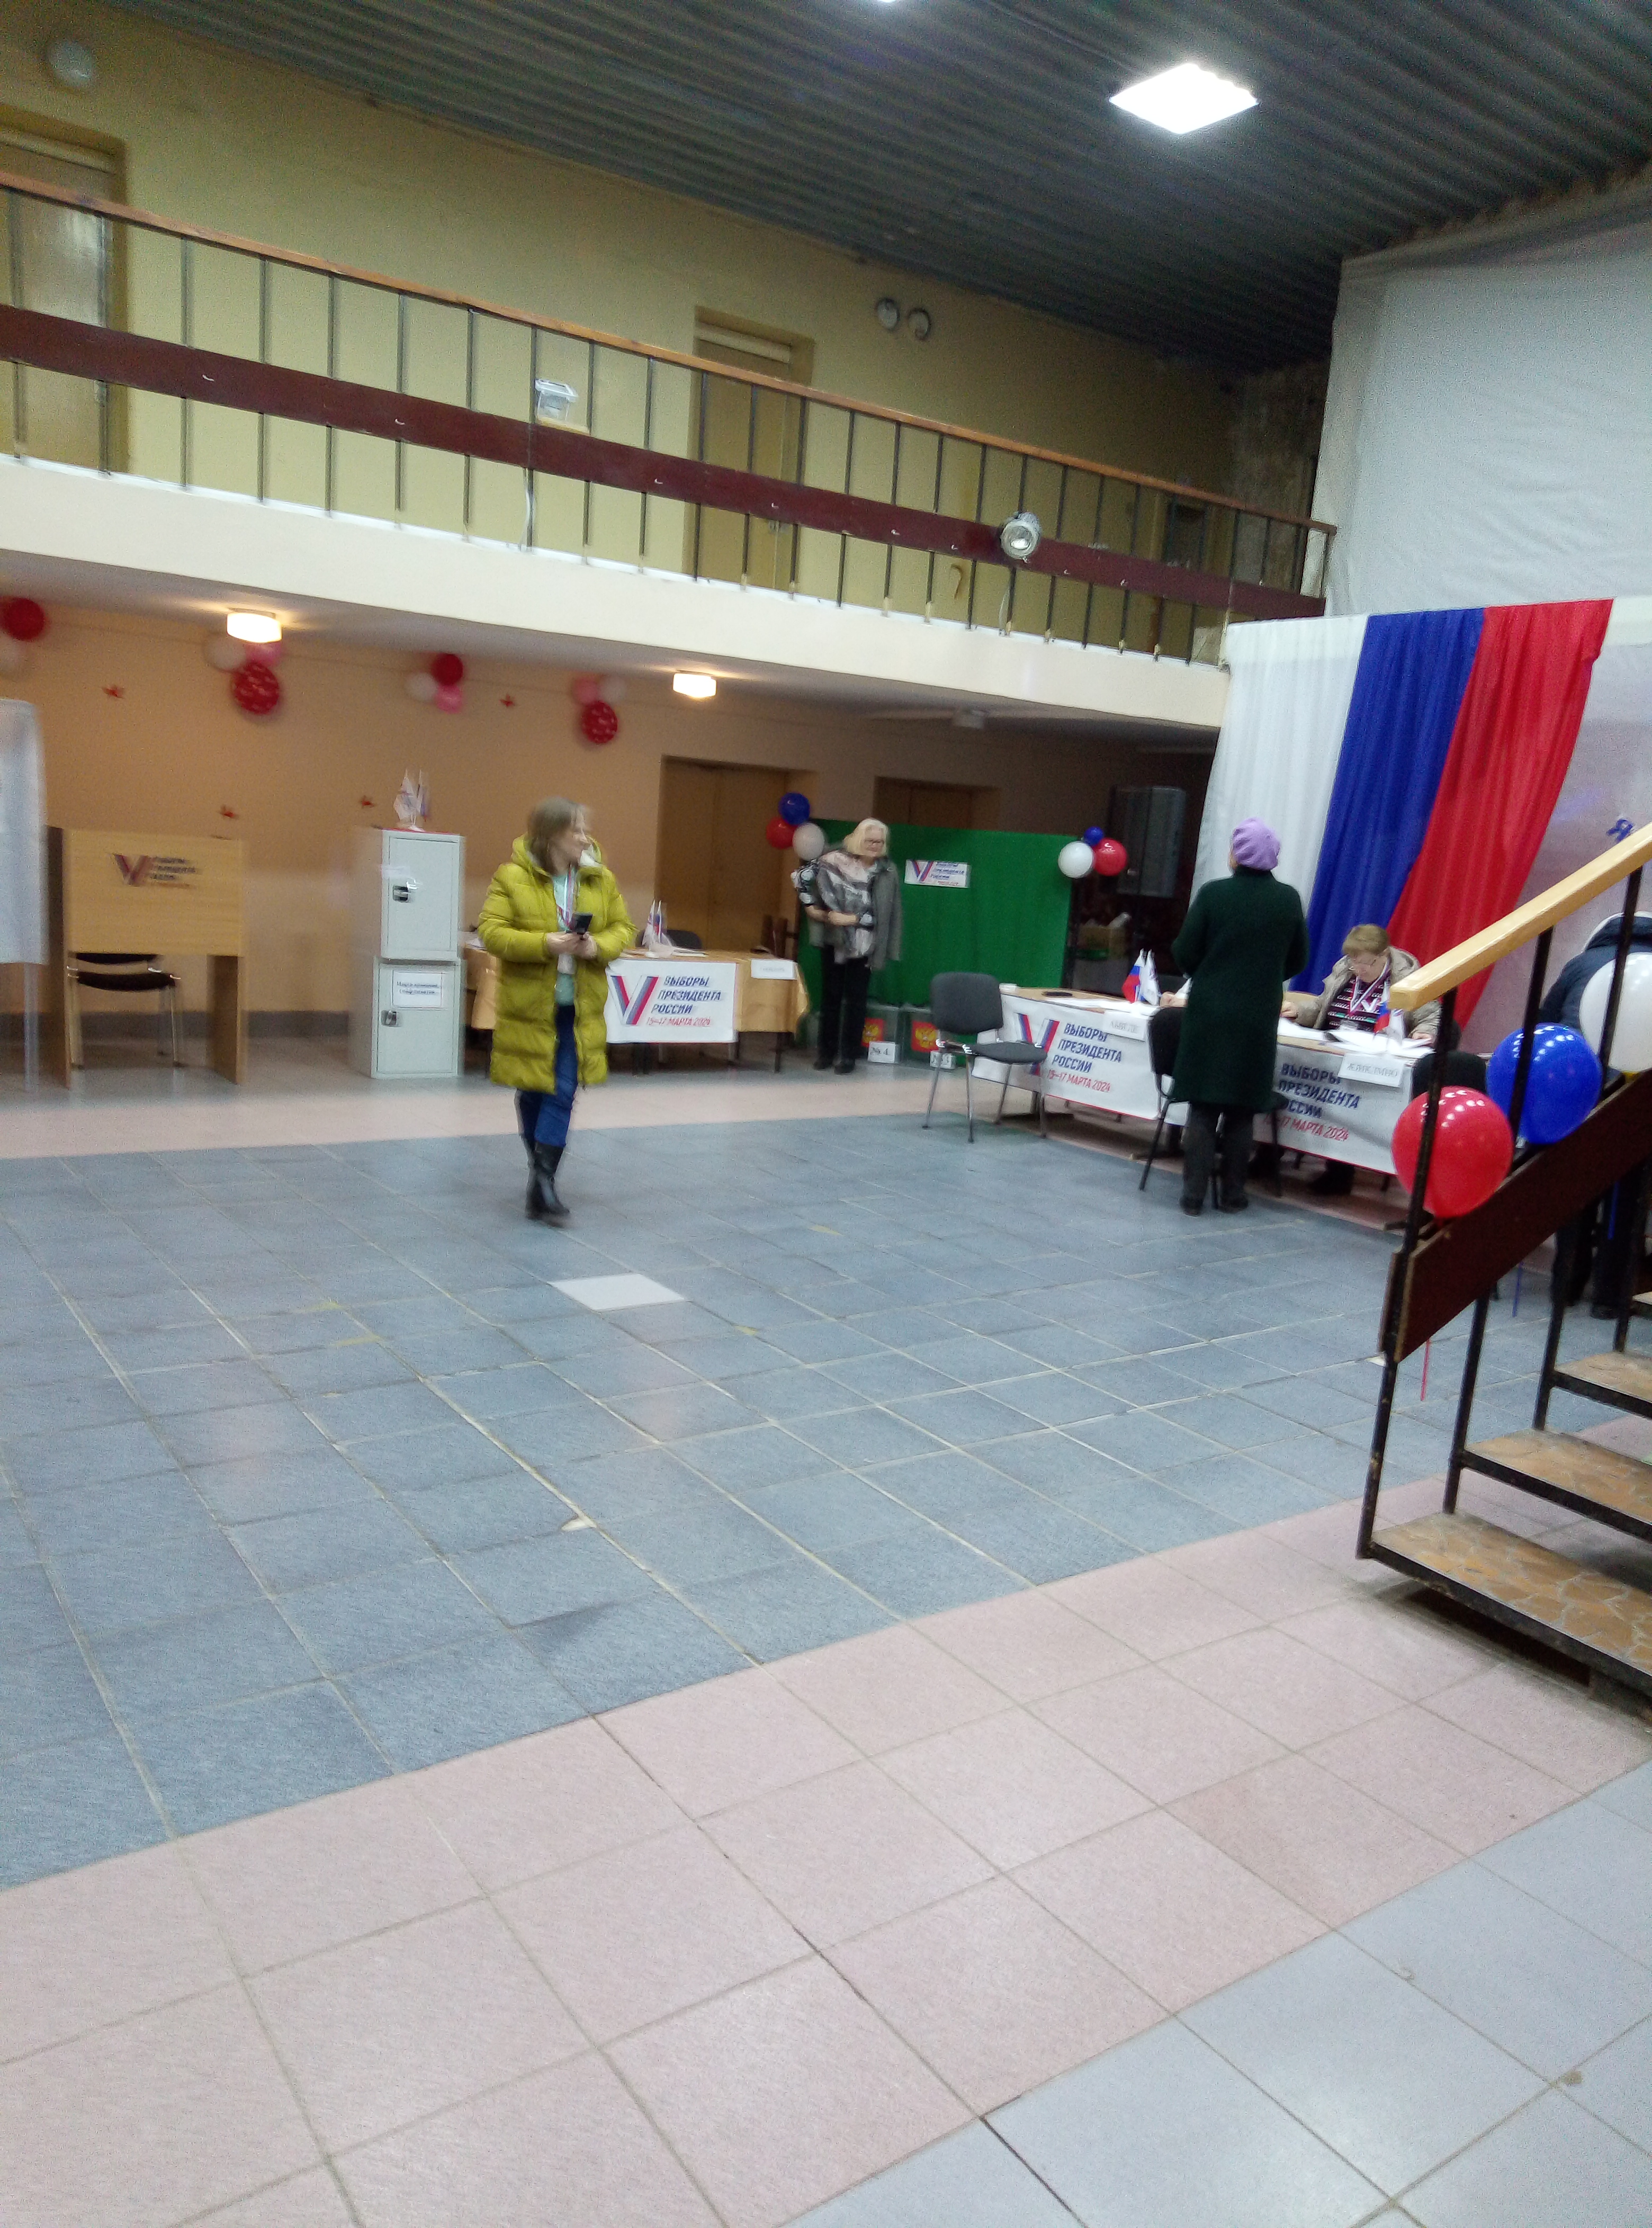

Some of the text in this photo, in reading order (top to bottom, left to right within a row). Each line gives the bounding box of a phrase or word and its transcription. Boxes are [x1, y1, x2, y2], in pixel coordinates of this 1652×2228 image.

[664, 975, 710, 987] ВЫБОРЫ
[657, 990, 722, 1002] ПРЕЗИДЕНТА
[651, 1003, 693, 1014] РОССИИ
[667, 1017, 692, 1026] МАРТА
[693, 1016, 711, 1027] 2024
[1064, 1022, 1108, 1042] ВЫБОРЫ
[1057, 1039, 1122, 1063] ПРЕЗИДЕНТА
[1052, 1055, 1092, 1073] РОССИИ
[1066, 1073, 1092, 1088] МАРТА
[1092, 1080, 1111, 1092] 2024
[1278, 1079, 1360, 1109] ПРЕЗИДЕНТА
[1287, 1099, 1323, 1118] ССИИ
[1291, 1118, 1324, 1136] МАРТА
[1323, 1126, 1349, 1142] 2024
